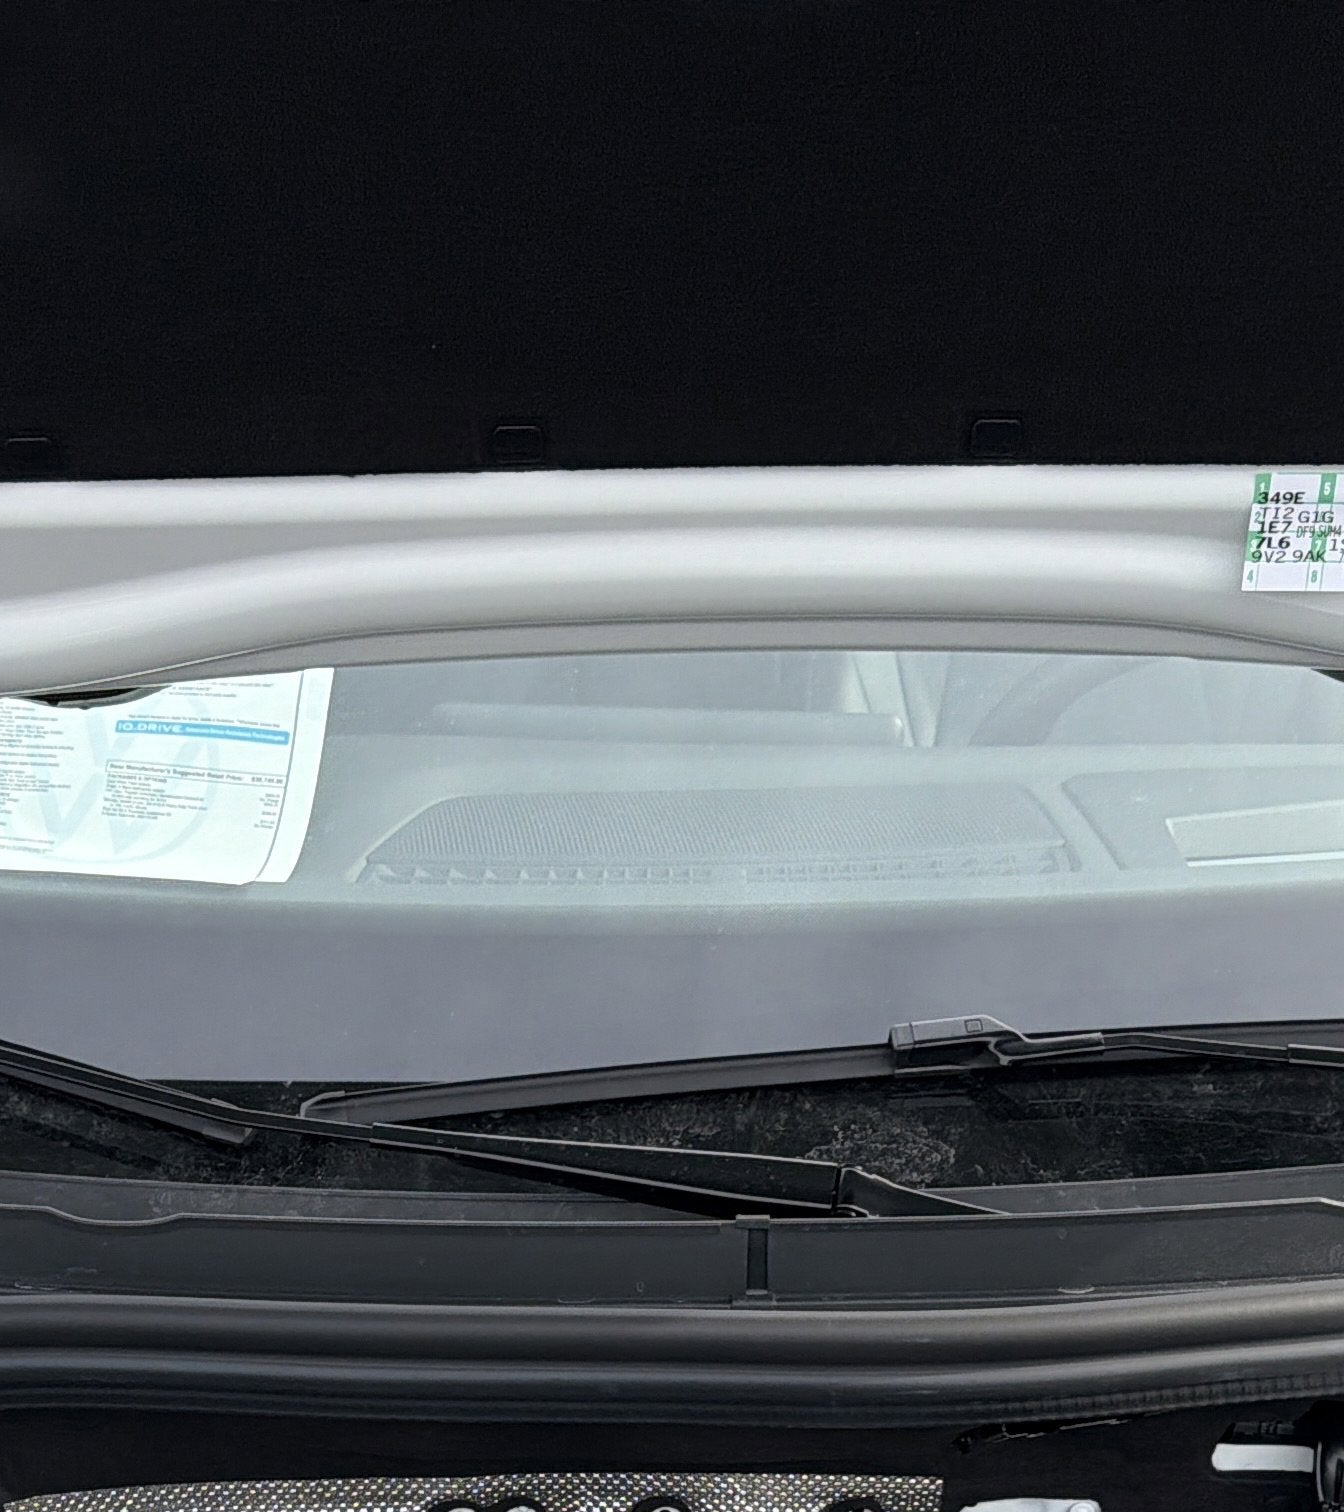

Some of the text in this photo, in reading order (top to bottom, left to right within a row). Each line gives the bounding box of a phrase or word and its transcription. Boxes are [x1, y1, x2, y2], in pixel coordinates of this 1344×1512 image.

[1323, 482, 1332, 496] 5
[1257, 491, 1306, 505] 349E
[1298, 510, 1335, 523] G1G
[1256, 520, 1293, 534] 1E7
[1256, 536, 1291, 549] 7L6
